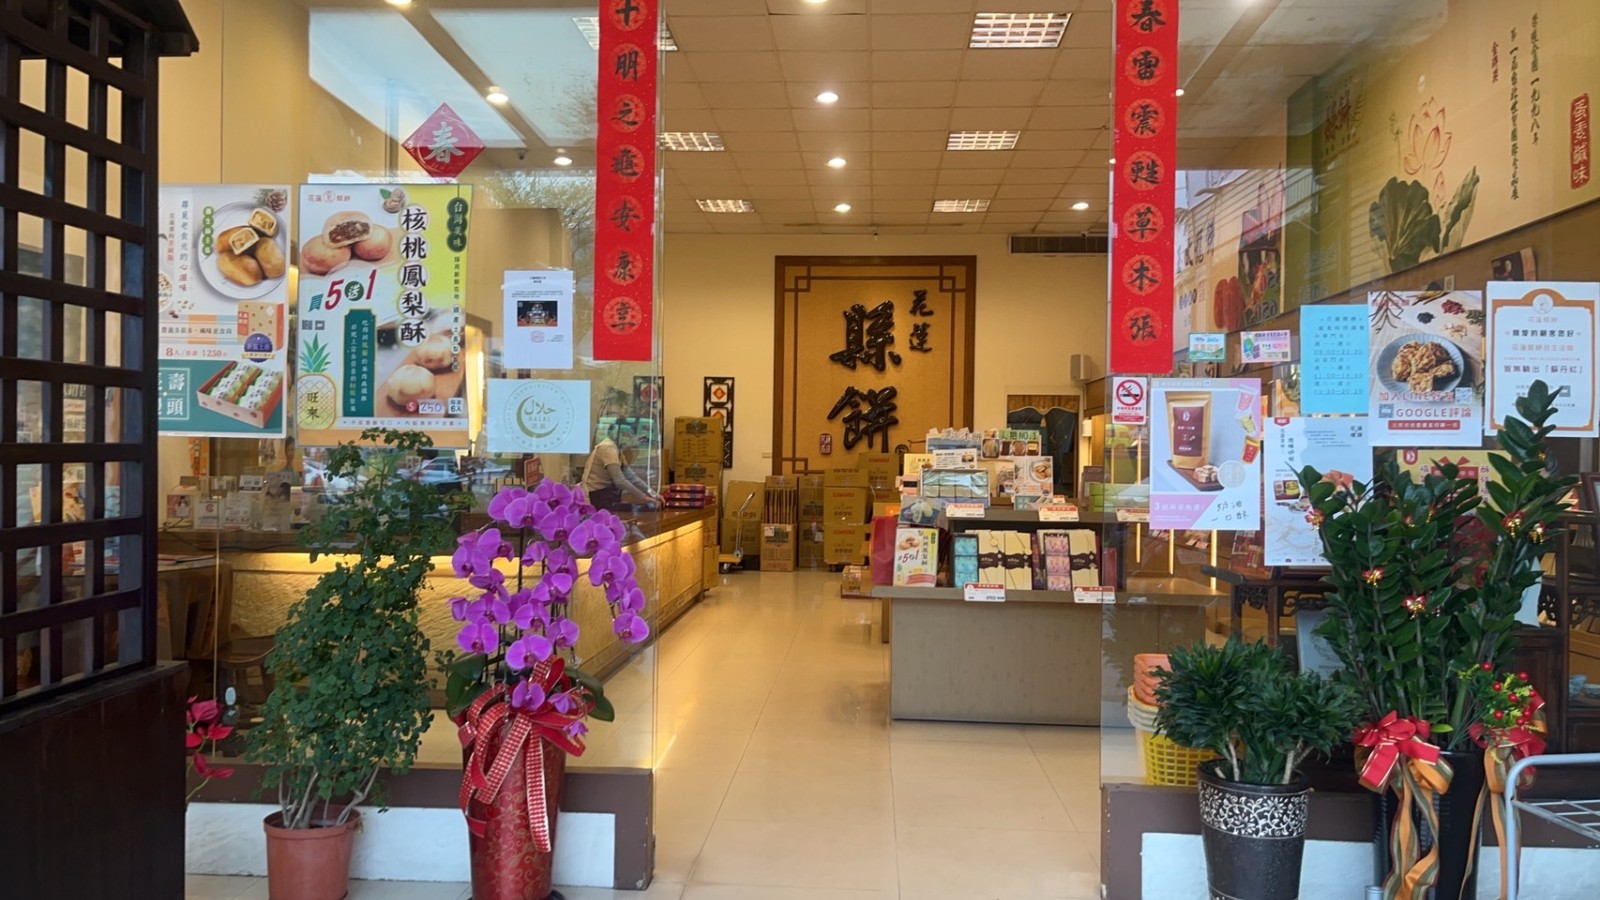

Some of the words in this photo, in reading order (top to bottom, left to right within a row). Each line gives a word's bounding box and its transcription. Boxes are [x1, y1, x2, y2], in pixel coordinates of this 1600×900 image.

[424, 121, 465, 163] 春
[1127, 0, 1166, 341] 春雷震甦草木張
[452, 201, 464, 247] 台灣美味
[308, 269, 377, 312] 買5送1
[400, 208, 427, 344] 核桃鳳梨酥
[909, 289, 934, 353] 花蓮
[1512, 329, 1574, 337] 親愛的顧客您好
[828, 300, 902, 453] 縣餅
[306, 391, 320, 420] 旺來
[419, 402, 443, 413] 250
[524, 399, 556, 415] حلال
[1396, 407, 1472, 418] GOOGLE評論
